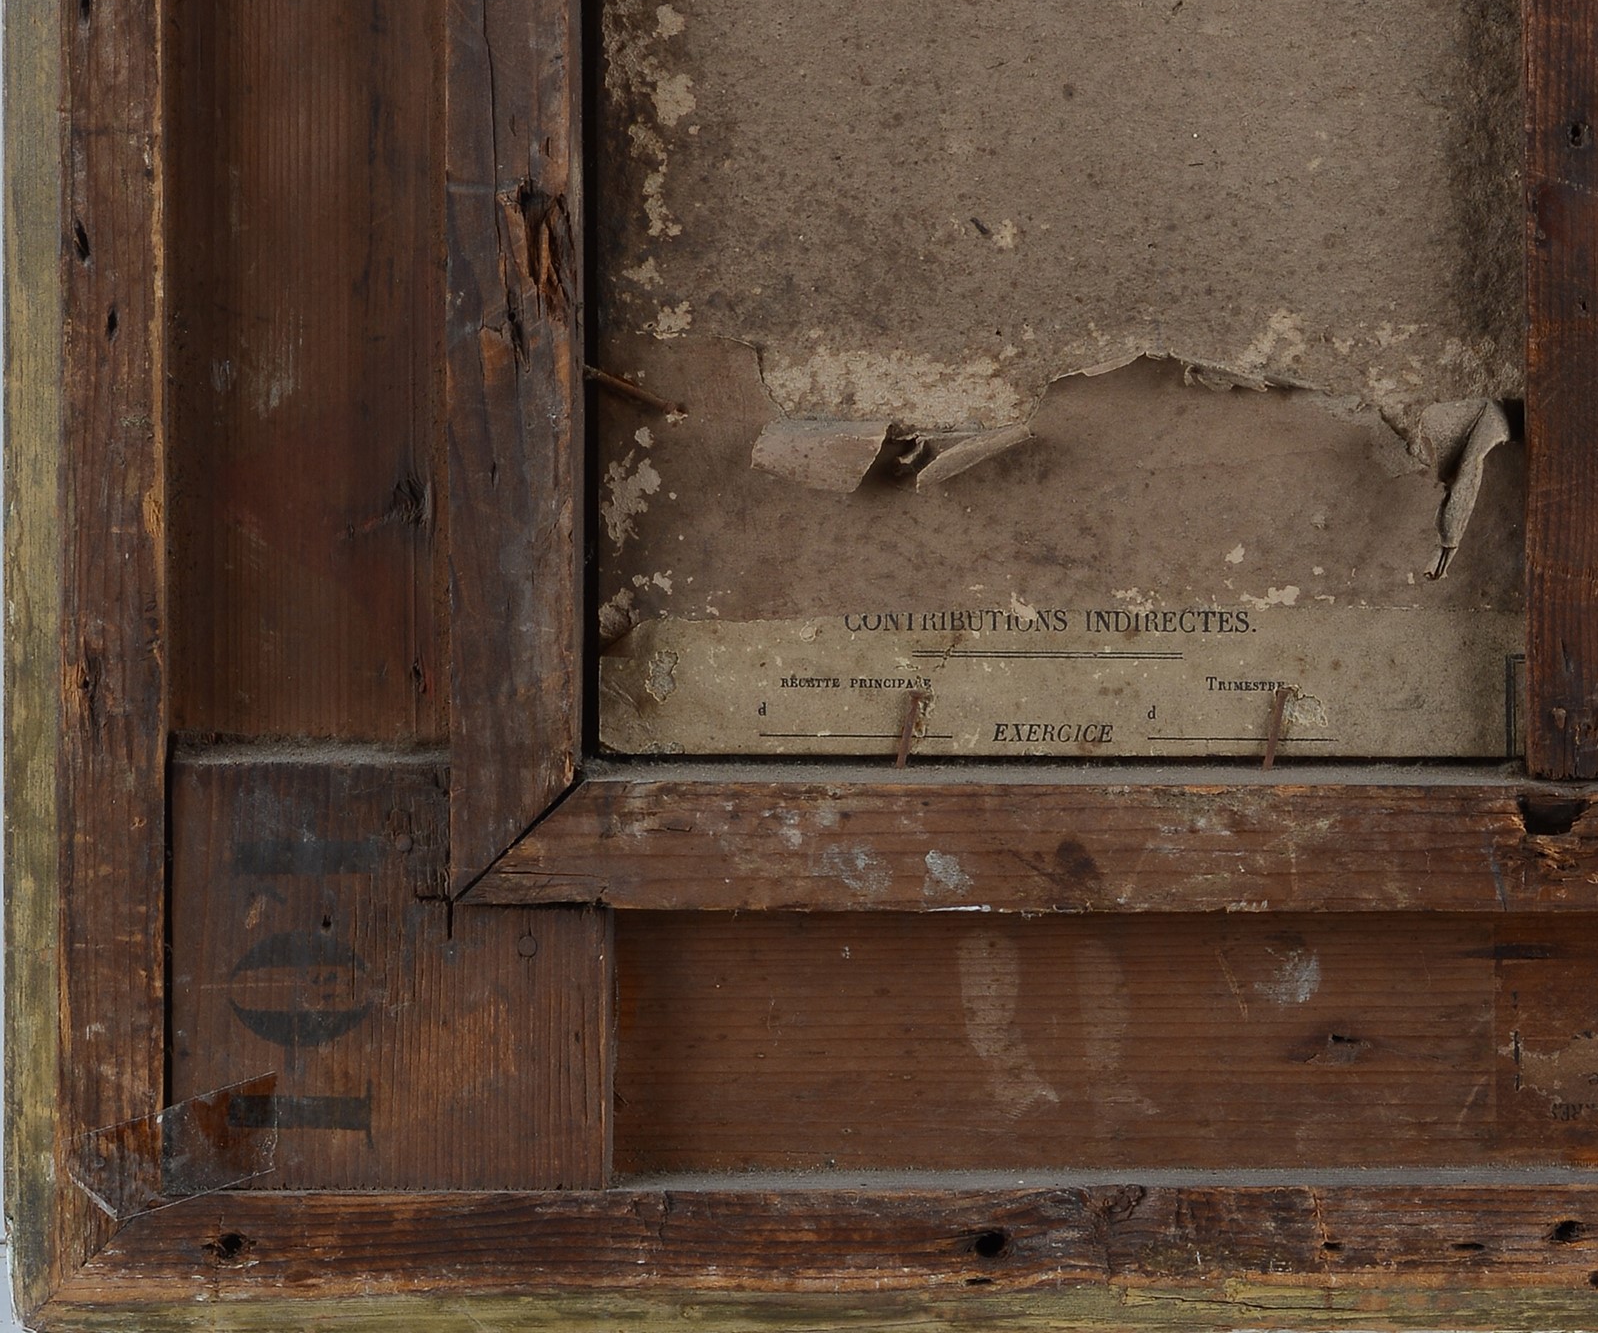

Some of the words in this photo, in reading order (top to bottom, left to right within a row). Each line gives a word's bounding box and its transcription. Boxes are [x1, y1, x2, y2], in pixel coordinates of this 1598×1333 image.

[1086, 609, 1257, 633] INDIRECTES.
[757, 702, 767, 716] d
[1147, 705, 1157, 720] d
[992, 723, 1114, 743] EXERCICE
